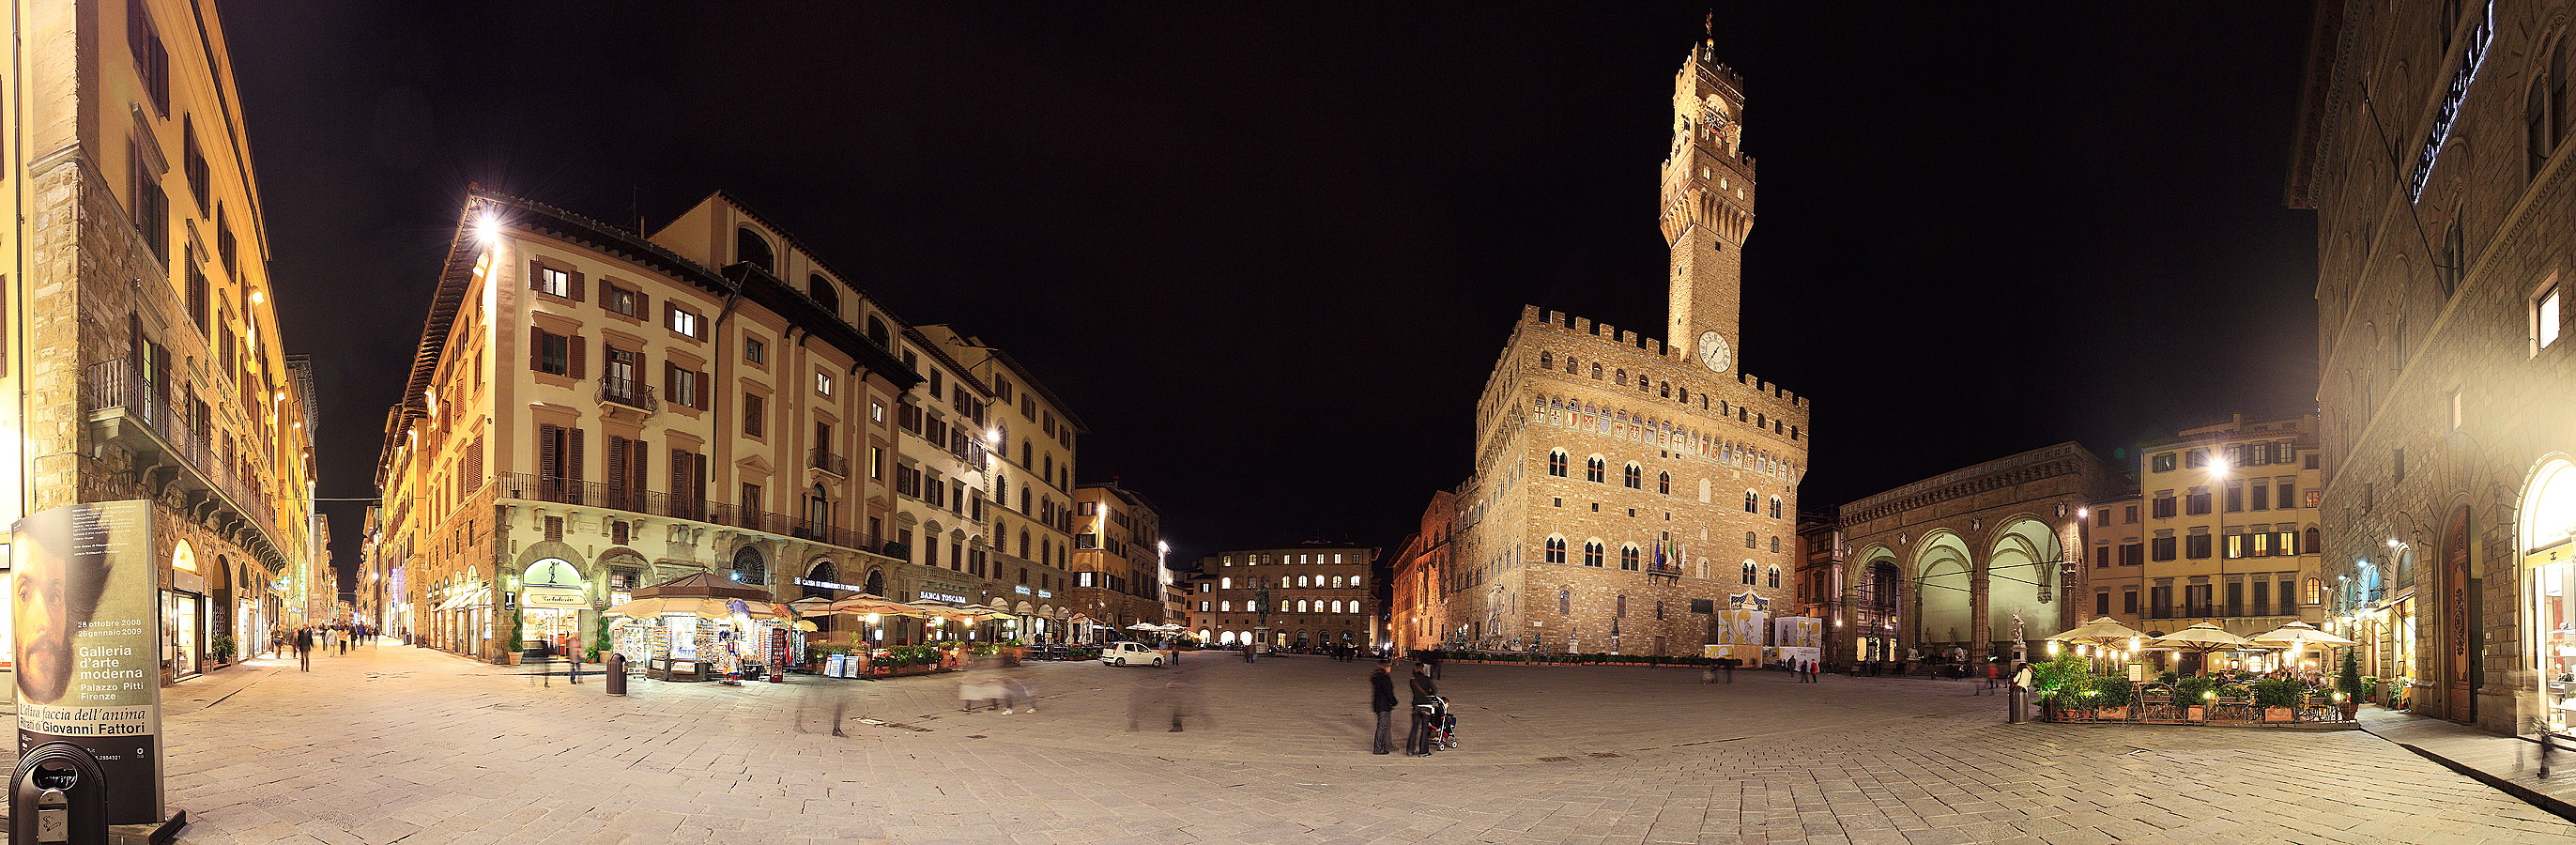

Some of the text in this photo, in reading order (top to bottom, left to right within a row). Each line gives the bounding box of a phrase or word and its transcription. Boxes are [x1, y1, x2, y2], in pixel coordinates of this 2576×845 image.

[920, 591, 966, 604] BANCA TOSCANA
[88, 629, 121, 638] gennaio
[79, 645, 132, 657] Galleria
[80, 658, 120, 668] d'arte
[80, 668, 143, 679] moderna
[123, 682, 143, 690] Pitti
[42, 707, 71, 721] faccia
[35, 721, 41, 731] di
[43, 722, 93, 734] Giovanni
[99, 722, 145, 734] Fattori
